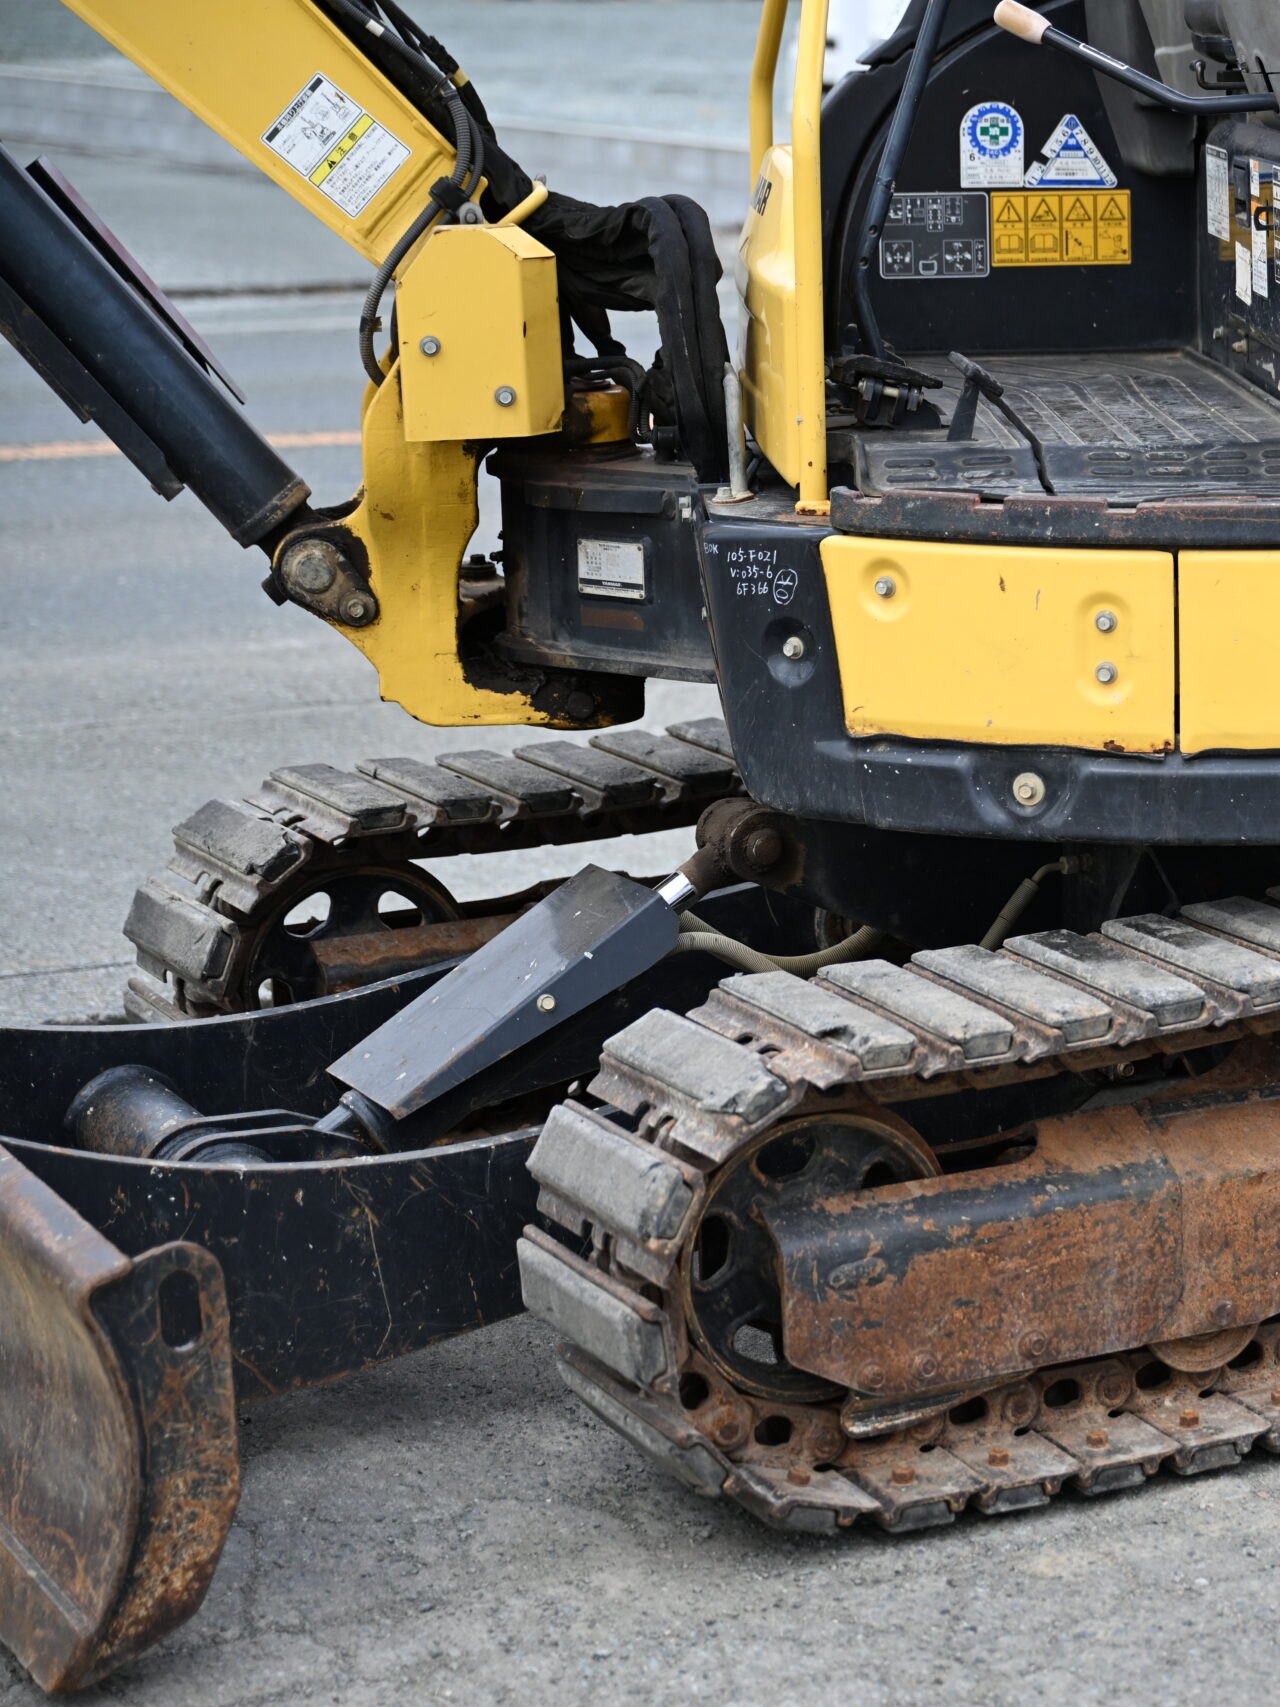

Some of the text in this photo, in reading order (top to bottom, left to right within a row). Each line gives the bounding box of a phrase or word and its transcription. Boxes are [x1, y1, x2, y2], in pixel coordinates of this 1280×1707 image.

[335, 132, 358, 157] 注意
[969, 153, 976, 162] 6
[736, 581, 769, 596] 6F366
